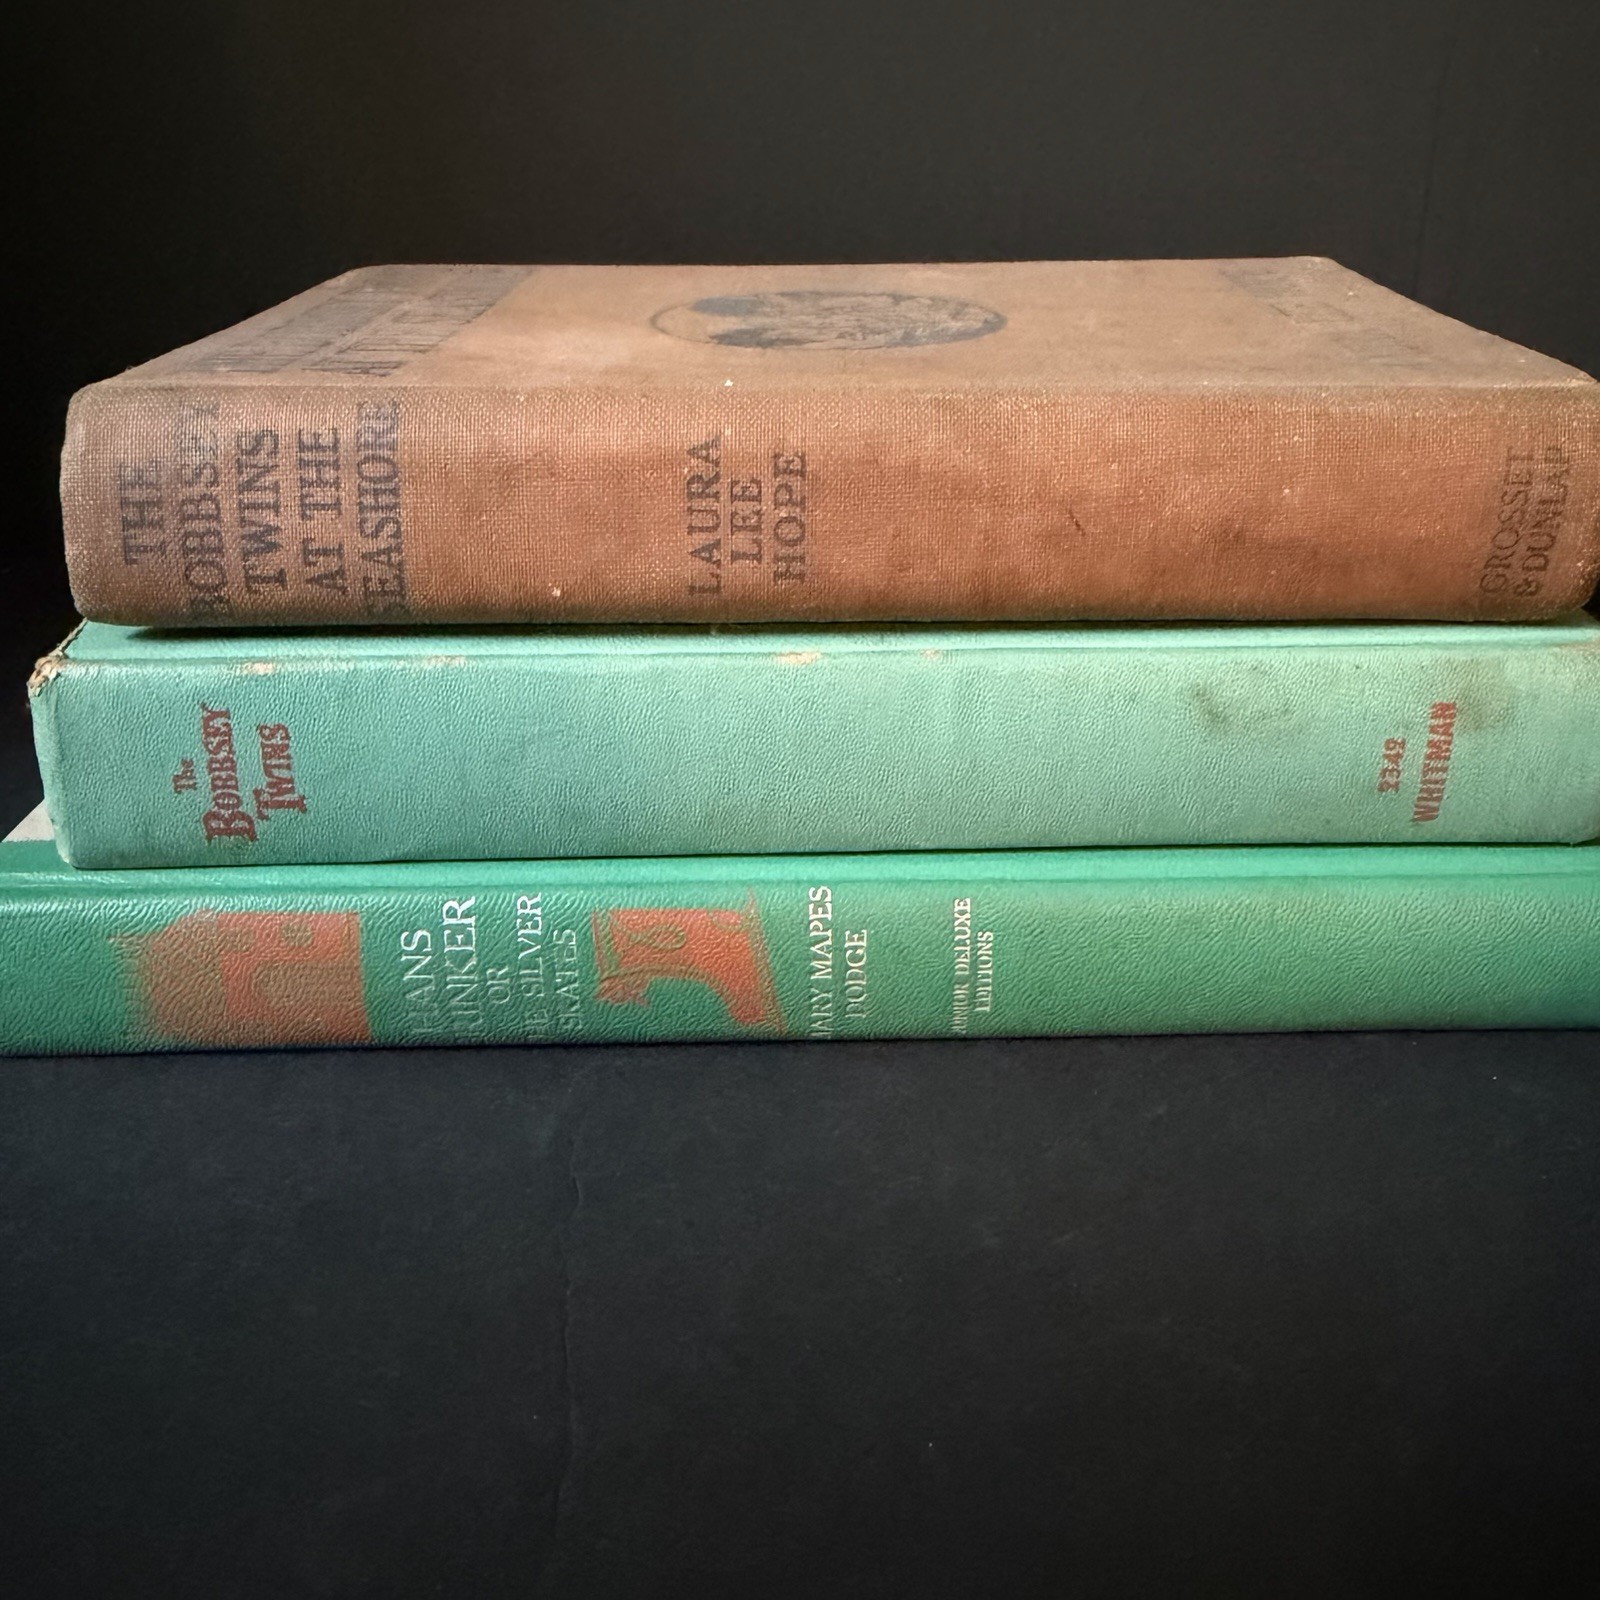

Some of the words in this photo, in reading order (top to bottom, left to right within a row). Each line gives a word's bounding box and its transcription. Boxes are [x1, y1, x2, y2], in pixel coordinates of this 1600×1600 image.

[120, 459, 165, 565] THE
[237, 428, 286, 592] TWINS
[298, 427, 342, 520] THE
[686, 436, 722, 596] LAURA
[731, 477, 763, 565] LEE
[772, 452, 807, 586] HOPE
[1479, 446, 1535, 594] GROSSET
[1521, 441, 1570, 573] DUNLAP
[302, 537, 346, 594] AT
[1514, 578, 1539, 598] &
[172, 759, 198, 795] The
[198, 702, 259, 843] BOBBSEY
[252, 723, 307, 820] TWINS
[1410, 701, 1457, 823] WHITMAN
[517, 892, 545, 998] SILVER
[808, 885, 833, 980] MAPES
[845, 929, 868, 1018] DODGE
[954, 898, 972, 976] DELUXE
[975, 930, 994, 1012] EDITIONS
[400, 929, 438, 1034] HANS
[486, 965, 511, 1005] OR
